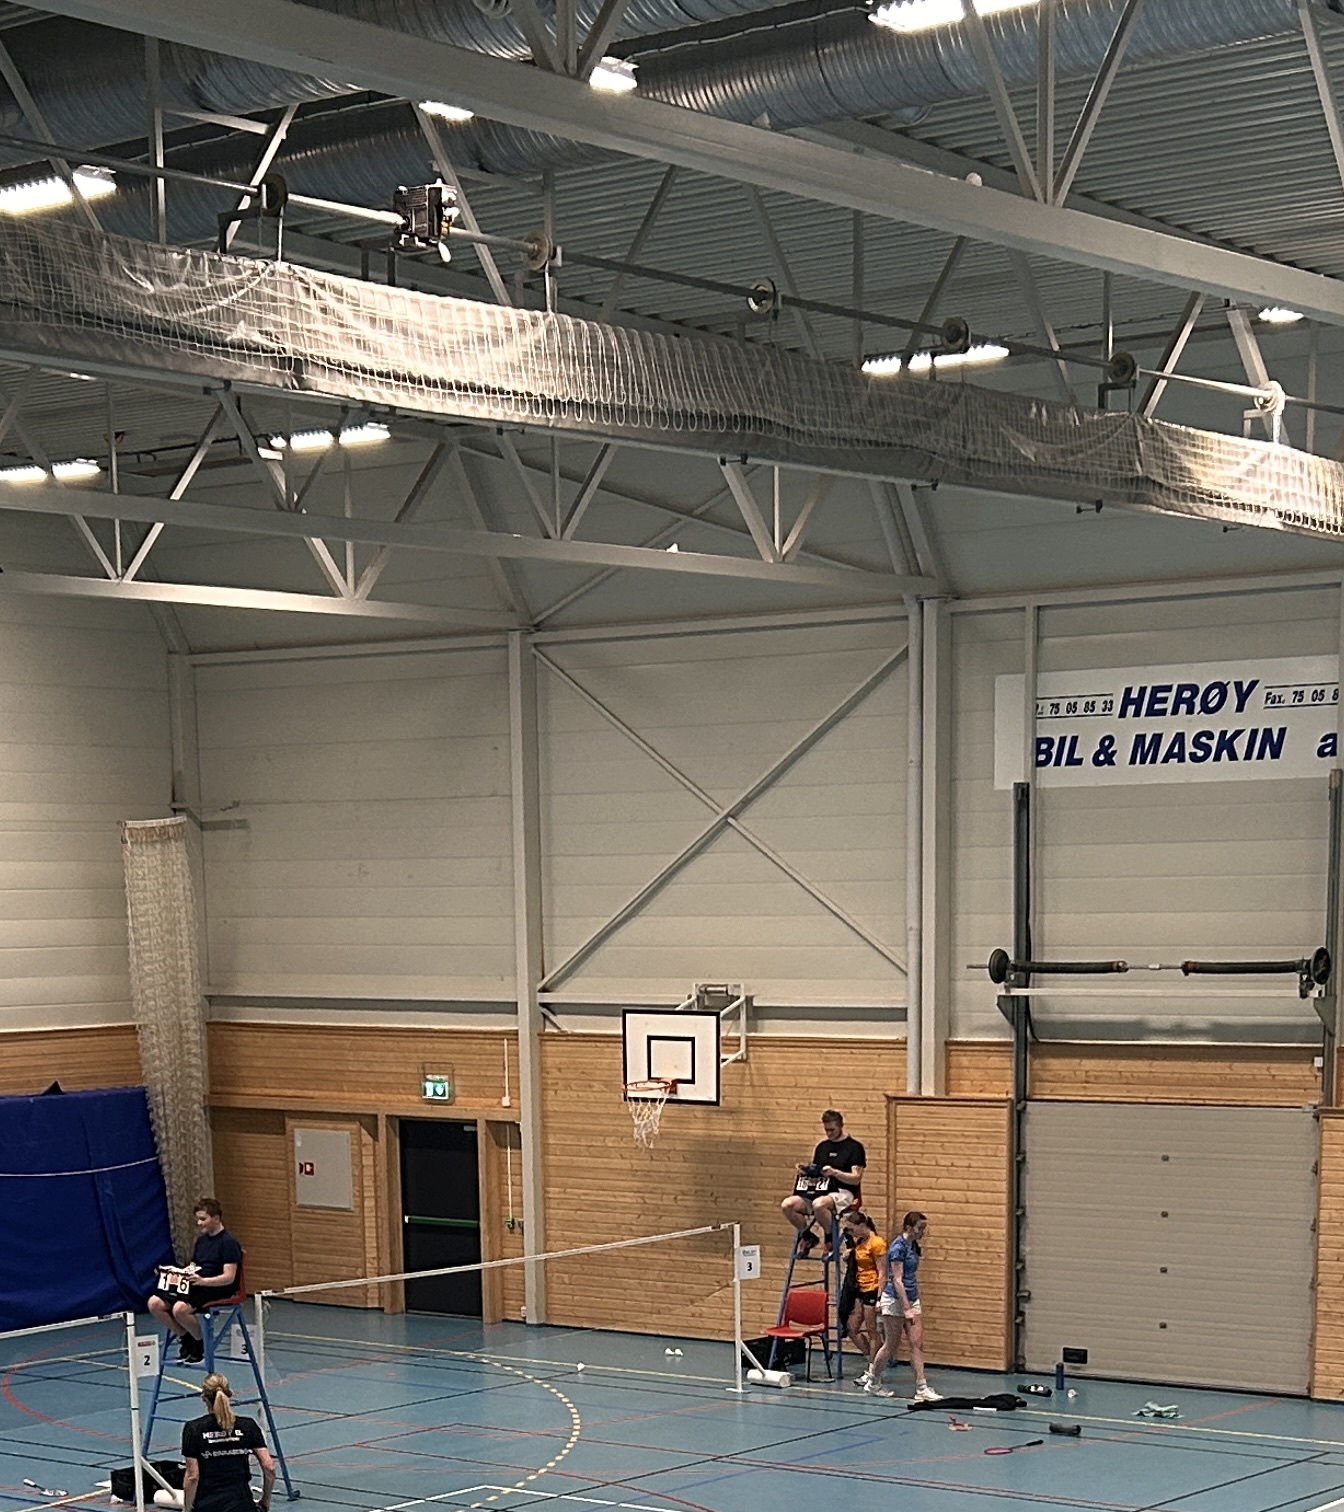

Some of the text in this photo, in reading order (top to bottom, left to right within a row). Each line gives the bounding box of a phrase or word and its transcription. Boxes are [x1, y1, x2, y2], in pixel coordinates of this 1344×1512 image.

[1118, 680, 1259, 718] HERØY
[1292, 689, 1304, 703] 75
[1311, 689, 1325, 702] 05
[1050, 702, 1060, 715] 75
[1066, 701, 1077, 714] 05
[1083, 700, 1096, 713] 85
[1101, 699, 1113, 712] 33
[1036, 734, 1083, 768] BIL
[1092, 732, 1117, 767] &
[1128, 727, 1287, 765] MASKIN
[747, 1261, 753, 1272] 3
[143, 1354, 151, 1366] 2
